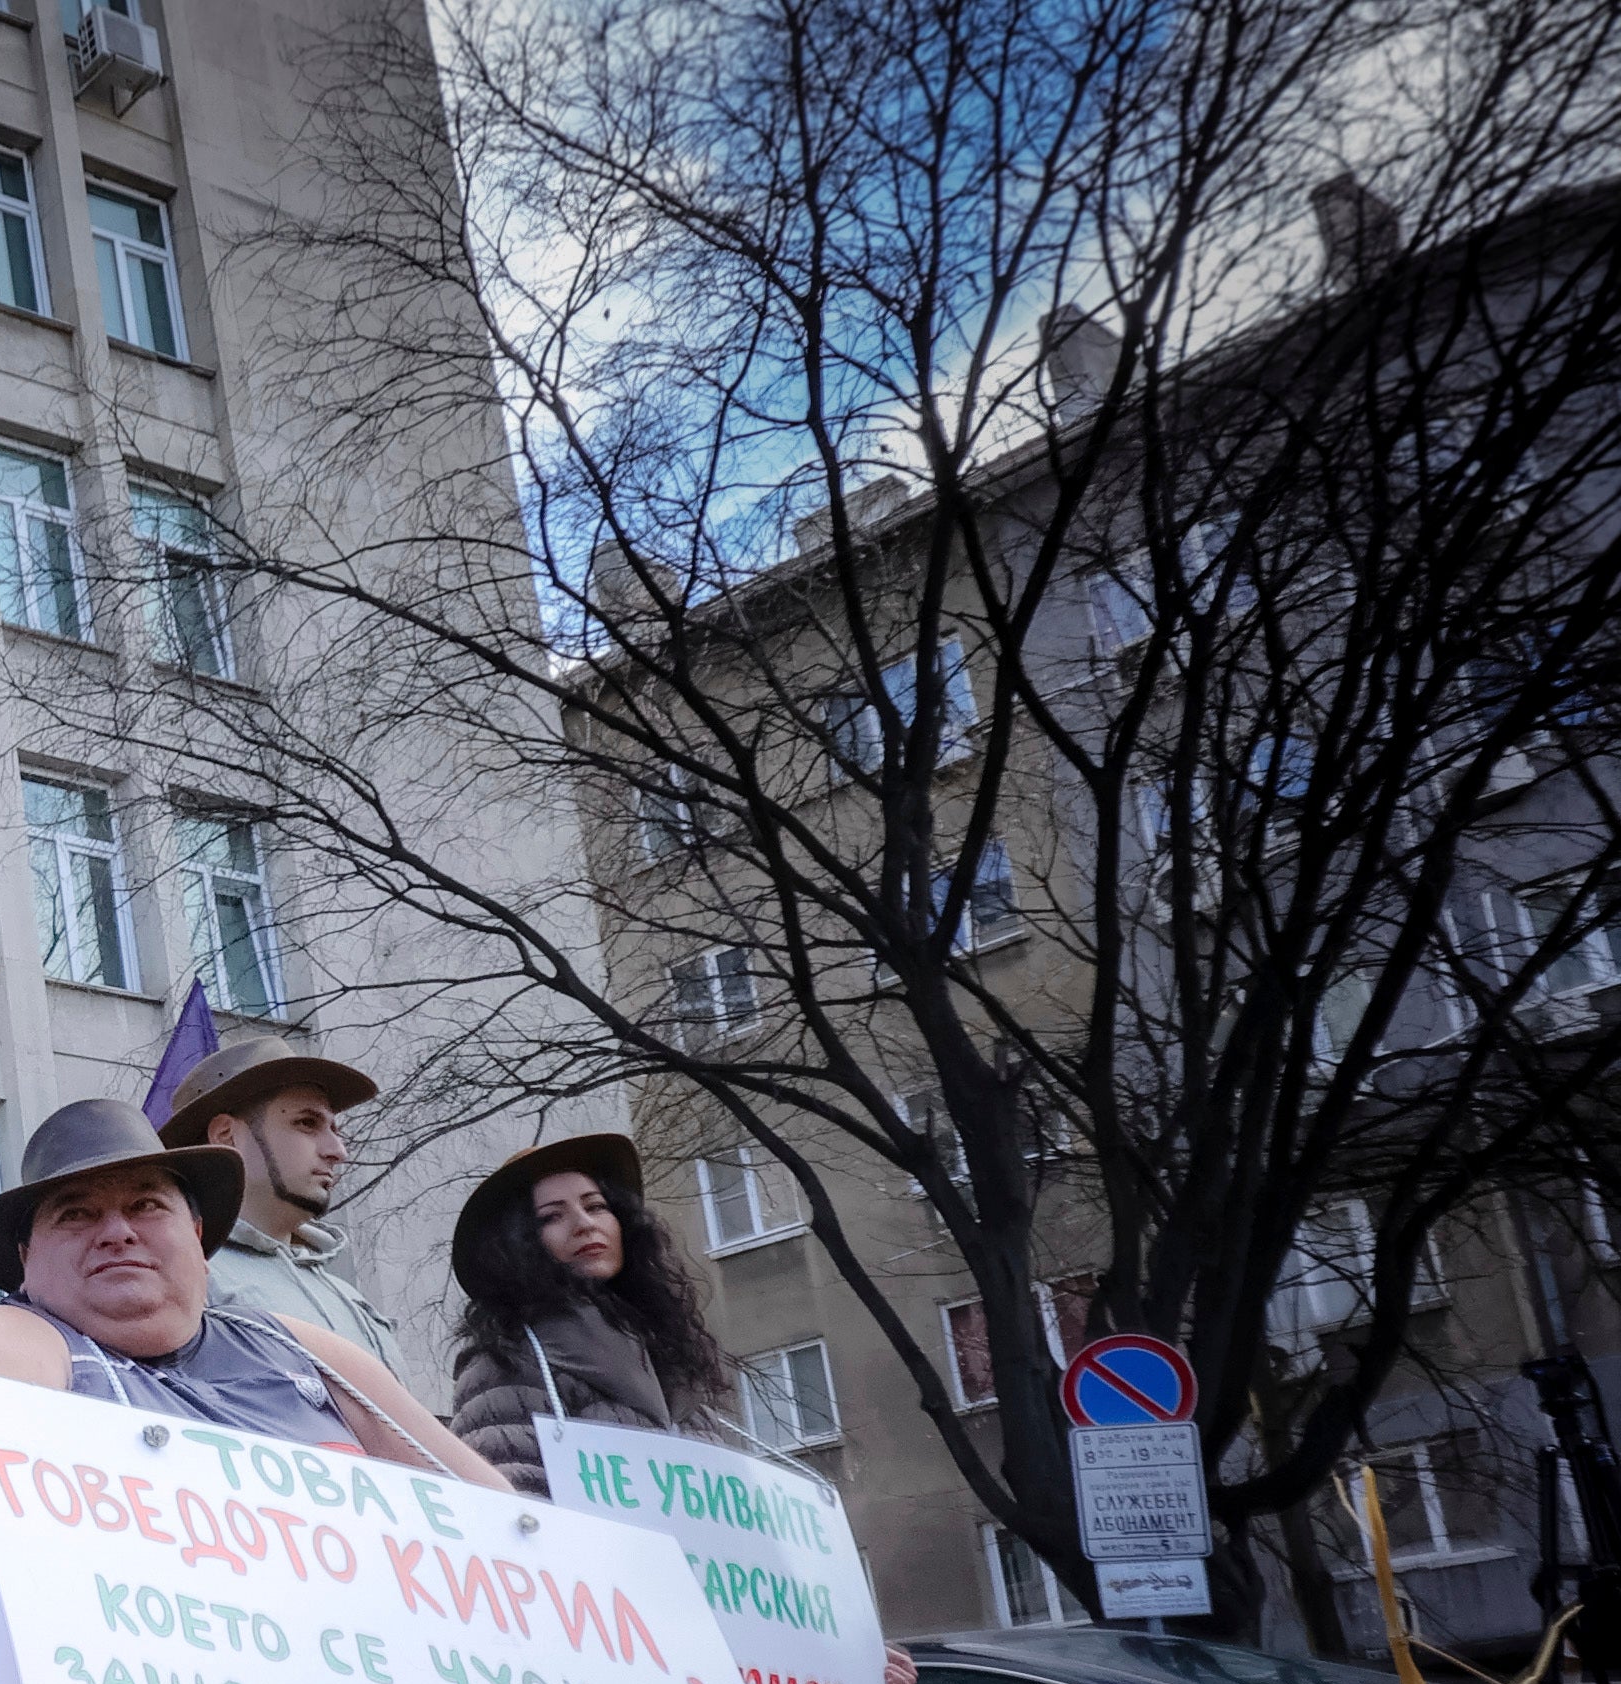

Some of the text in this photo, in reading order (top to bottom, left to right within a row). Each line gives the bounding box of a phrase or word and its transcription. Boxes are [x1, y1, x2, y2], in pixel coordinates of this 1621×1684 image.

[181, 1429, 464, 1540] ТОВА Е
[578, 1449, 832, 1554] НЕ УБИВАЙТЕ
[1093, 1512, 1197, 1533] АБОНАМЕНТ
[1094, 1493, 1190, 1512] СЛУЖЕБЕН
[94, 1573, 291, 1662] КОЕТО
